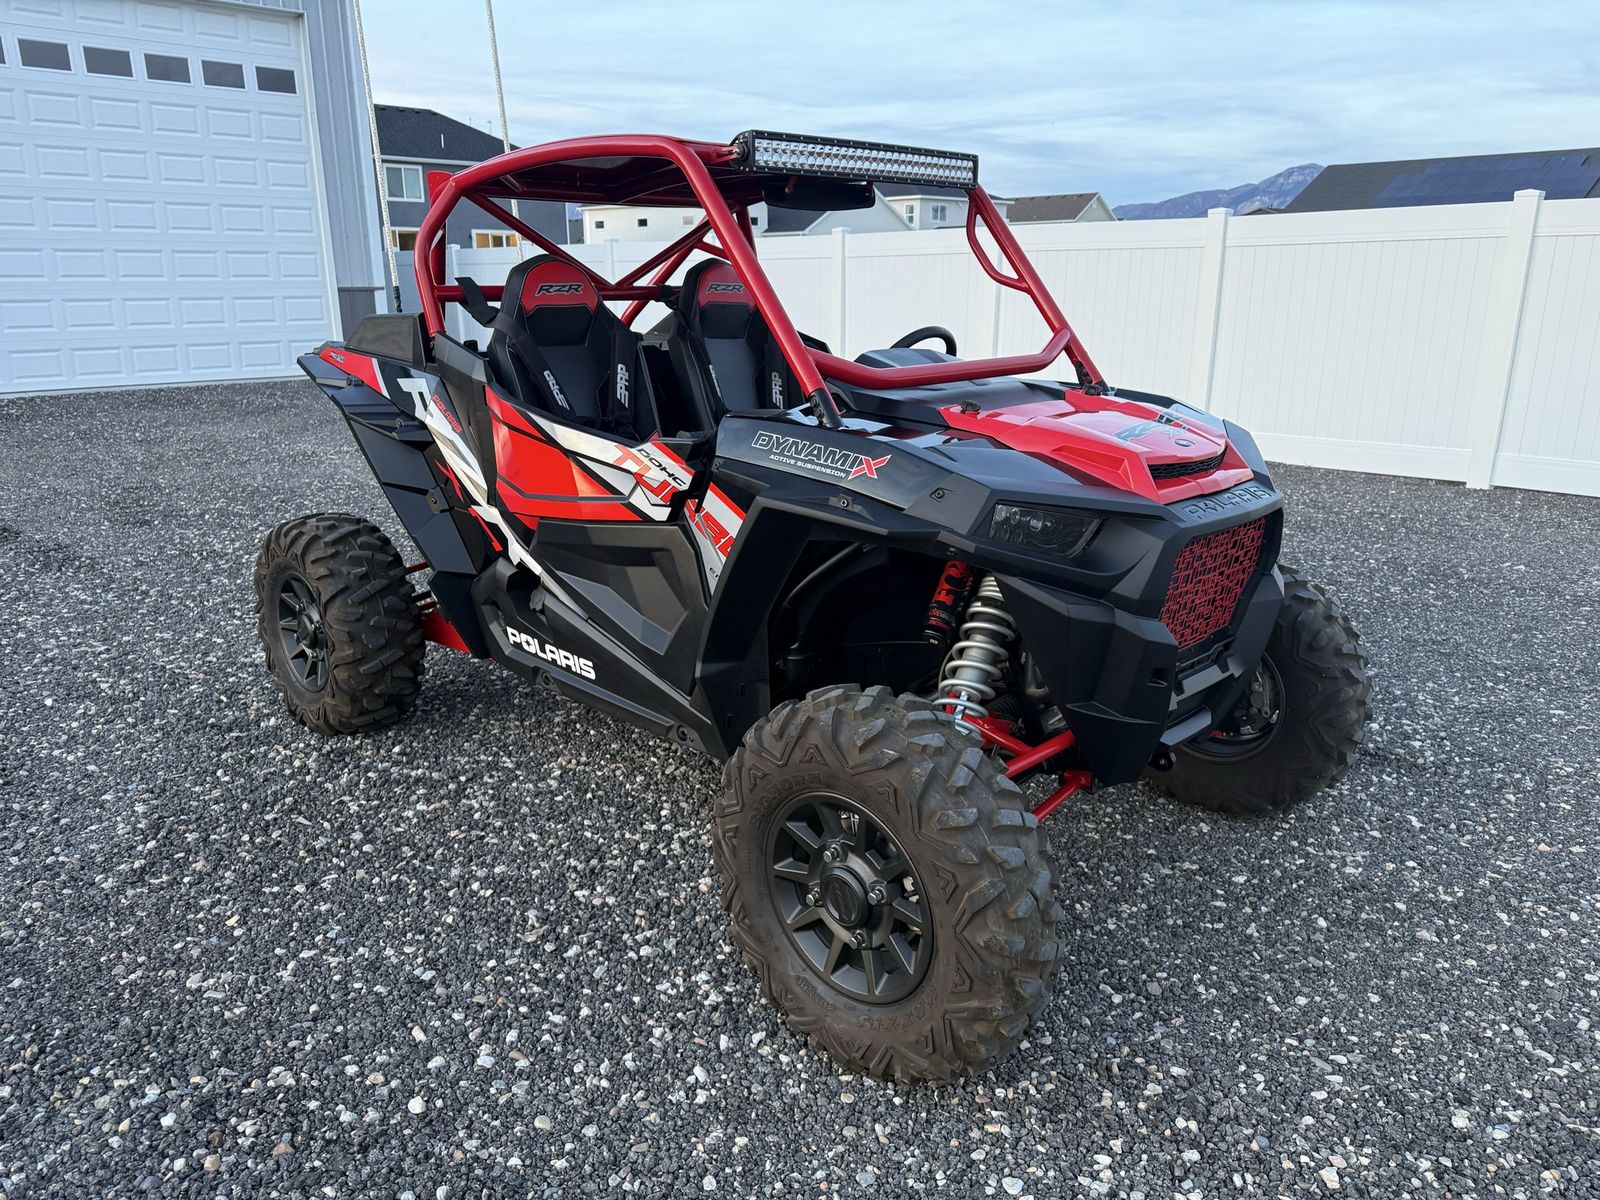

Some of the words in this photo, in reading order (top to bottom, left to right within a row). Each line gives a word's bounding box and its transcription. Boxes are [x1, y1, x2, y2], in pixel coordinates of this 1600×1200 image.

[535, 283, 583, 297] RZR
[706, 282, 744, 294] RZR
[431, 394, 463, 434] POLARIS
[636, 448, 687, 487] DOHC
[751, 430, 892, 480] DYNAMIX
[769, 454, 796, 466] ACTIVE
[796, 461, 847, 478] SUSPENSION
[1181, 485, 1272, 520] POLARIS
[506, 626, 596, 680] POLARIS
